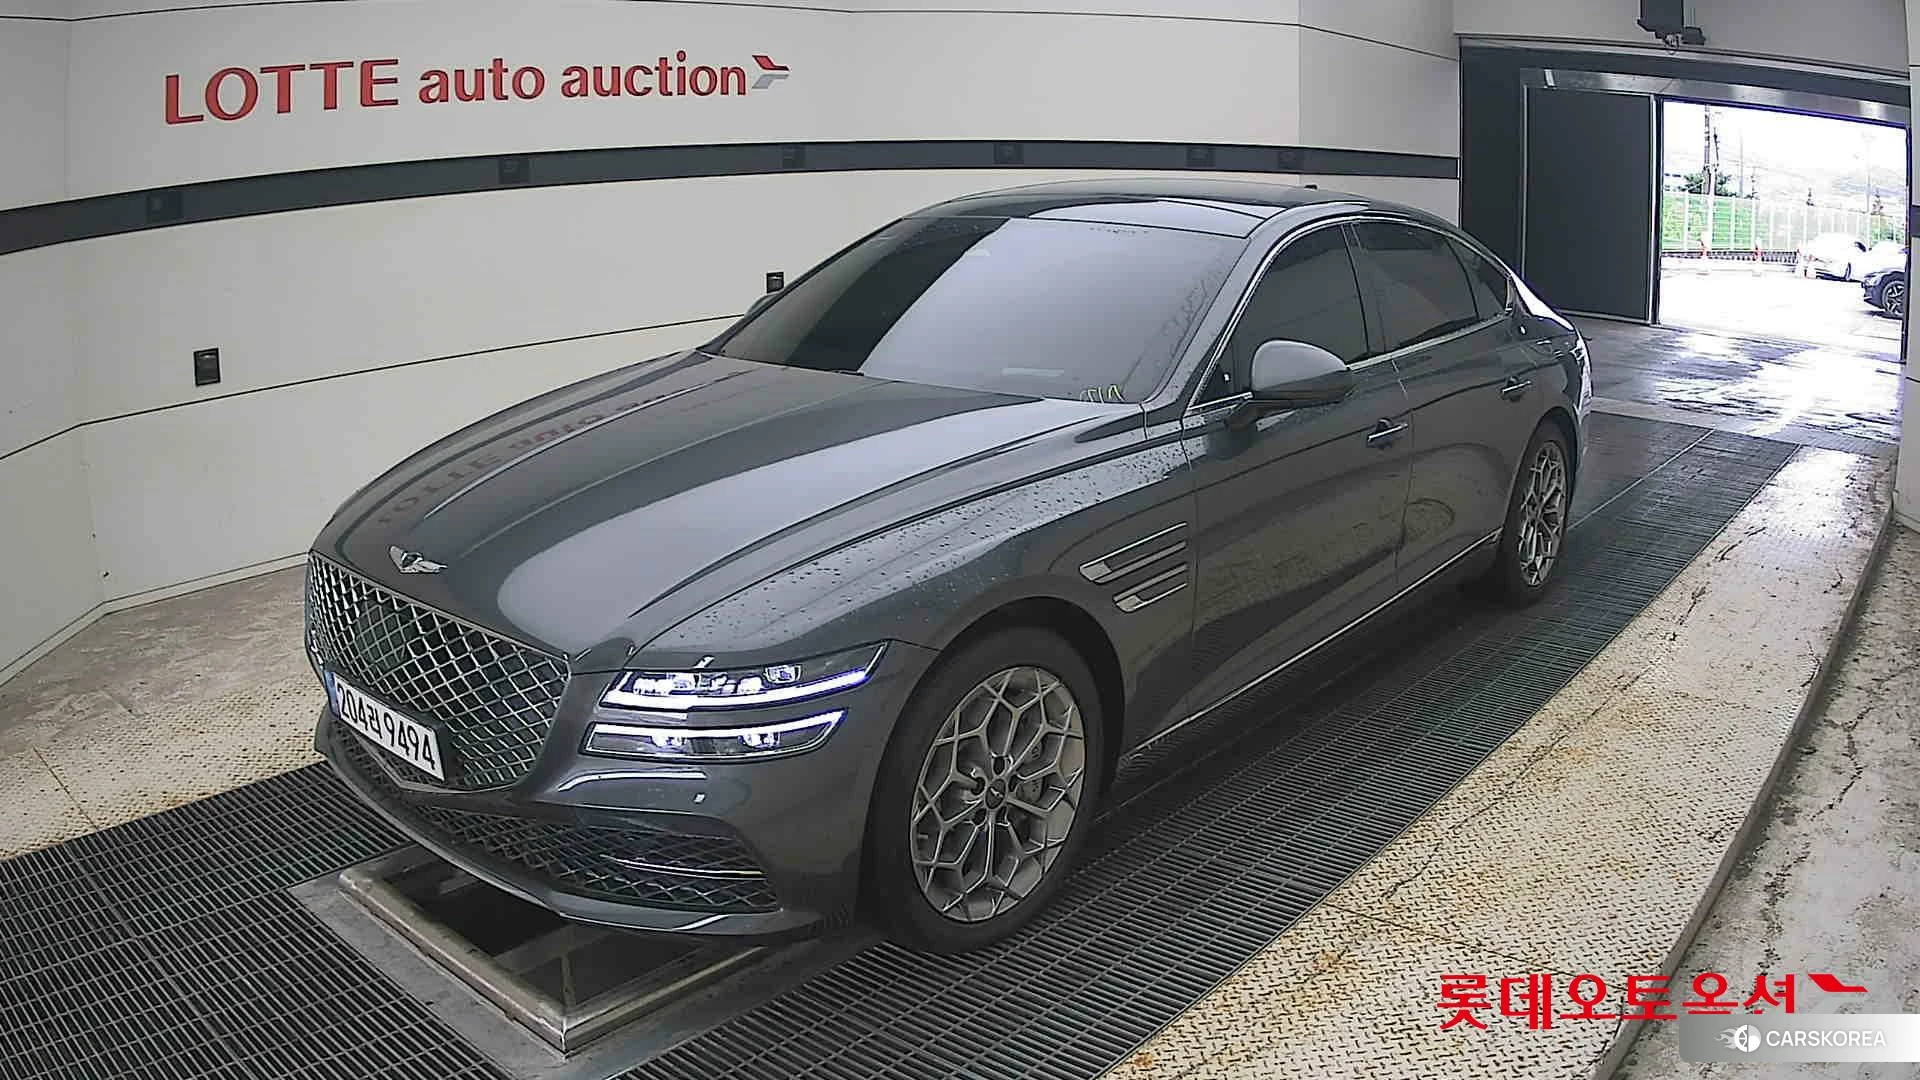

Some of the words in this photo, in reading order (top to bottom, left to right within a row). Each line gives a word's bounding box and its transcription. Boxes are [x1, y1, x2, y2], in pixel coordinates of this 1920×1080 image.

[165, 58, 399, 125] LOTTE
[418, 57, 546, 104] auto
[561, 50, 747, 98] auction
